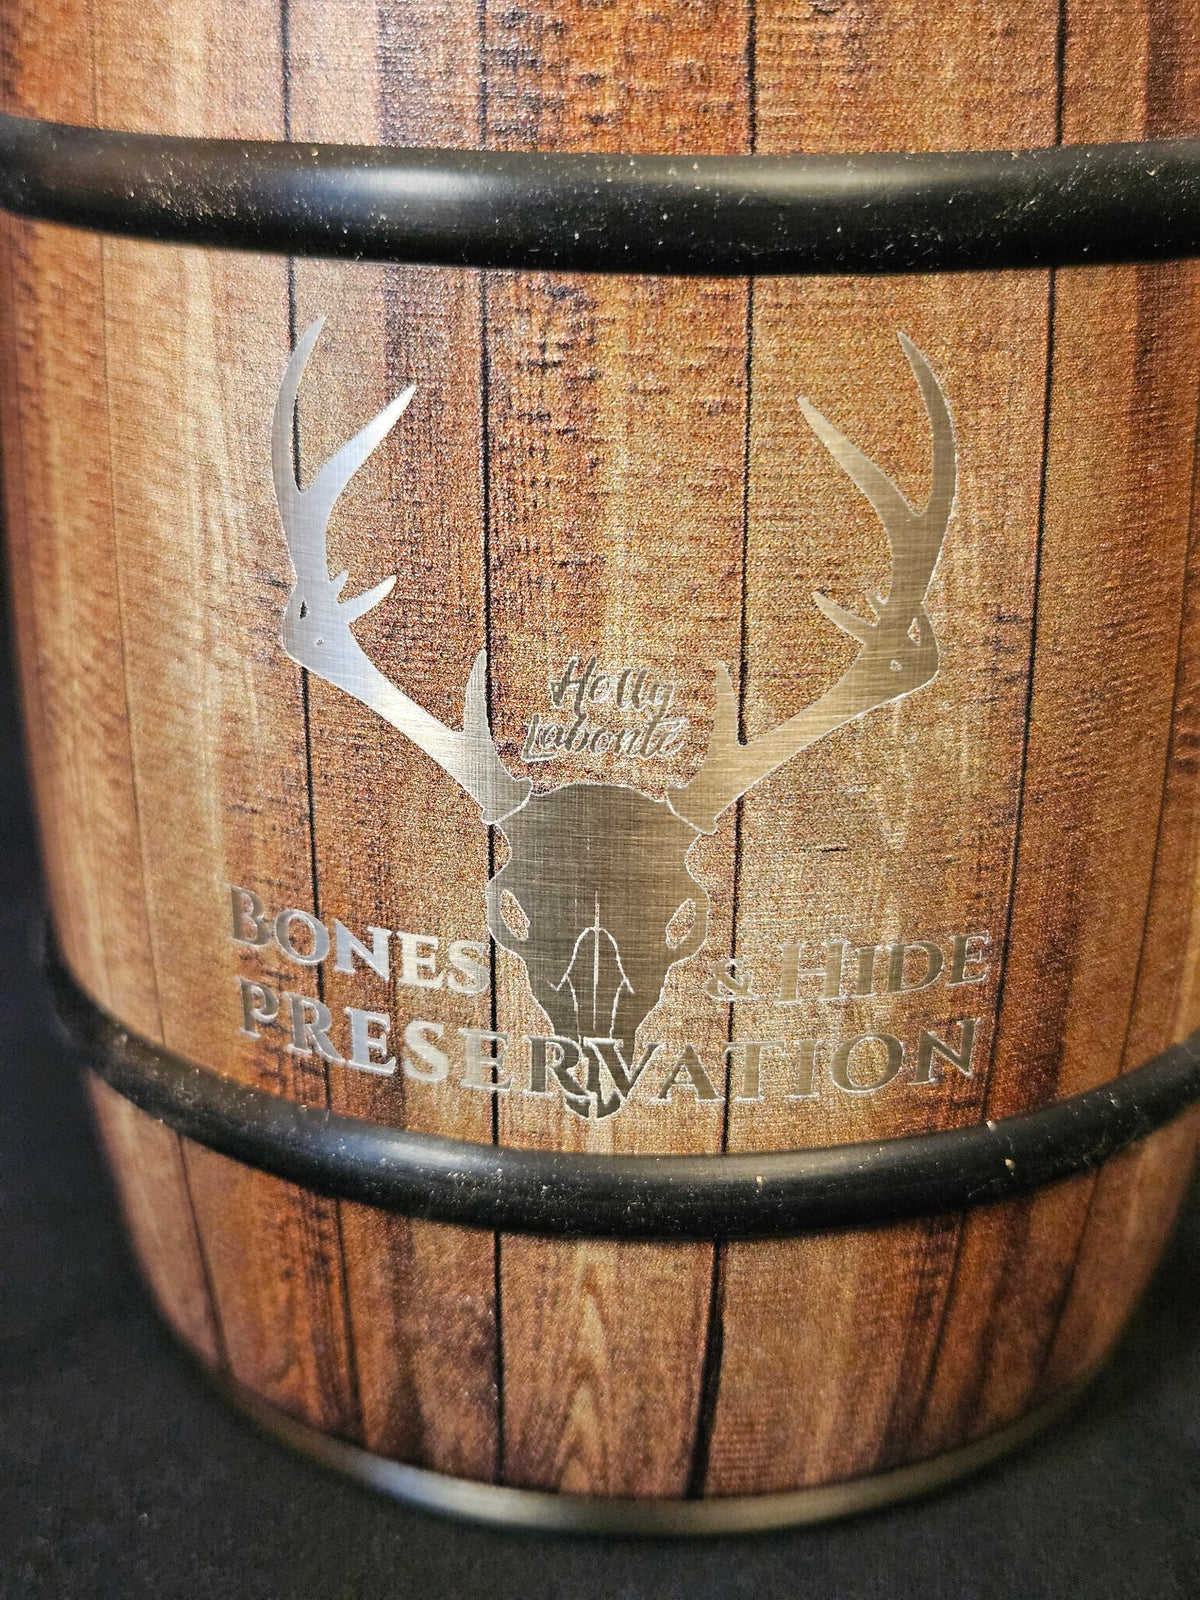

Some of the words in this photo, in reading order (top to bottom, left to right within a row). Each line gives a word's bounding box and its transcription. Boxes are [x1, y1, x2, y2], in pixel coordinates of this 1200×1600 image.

[549, 655, 676, 724] Holly
[229, 884, 491, 996] BONES
[705, 957, 757, 1001] &
[774, 930, 990, 1006] HIDE
[237, 975, 982, 1103] PRESERVATION
